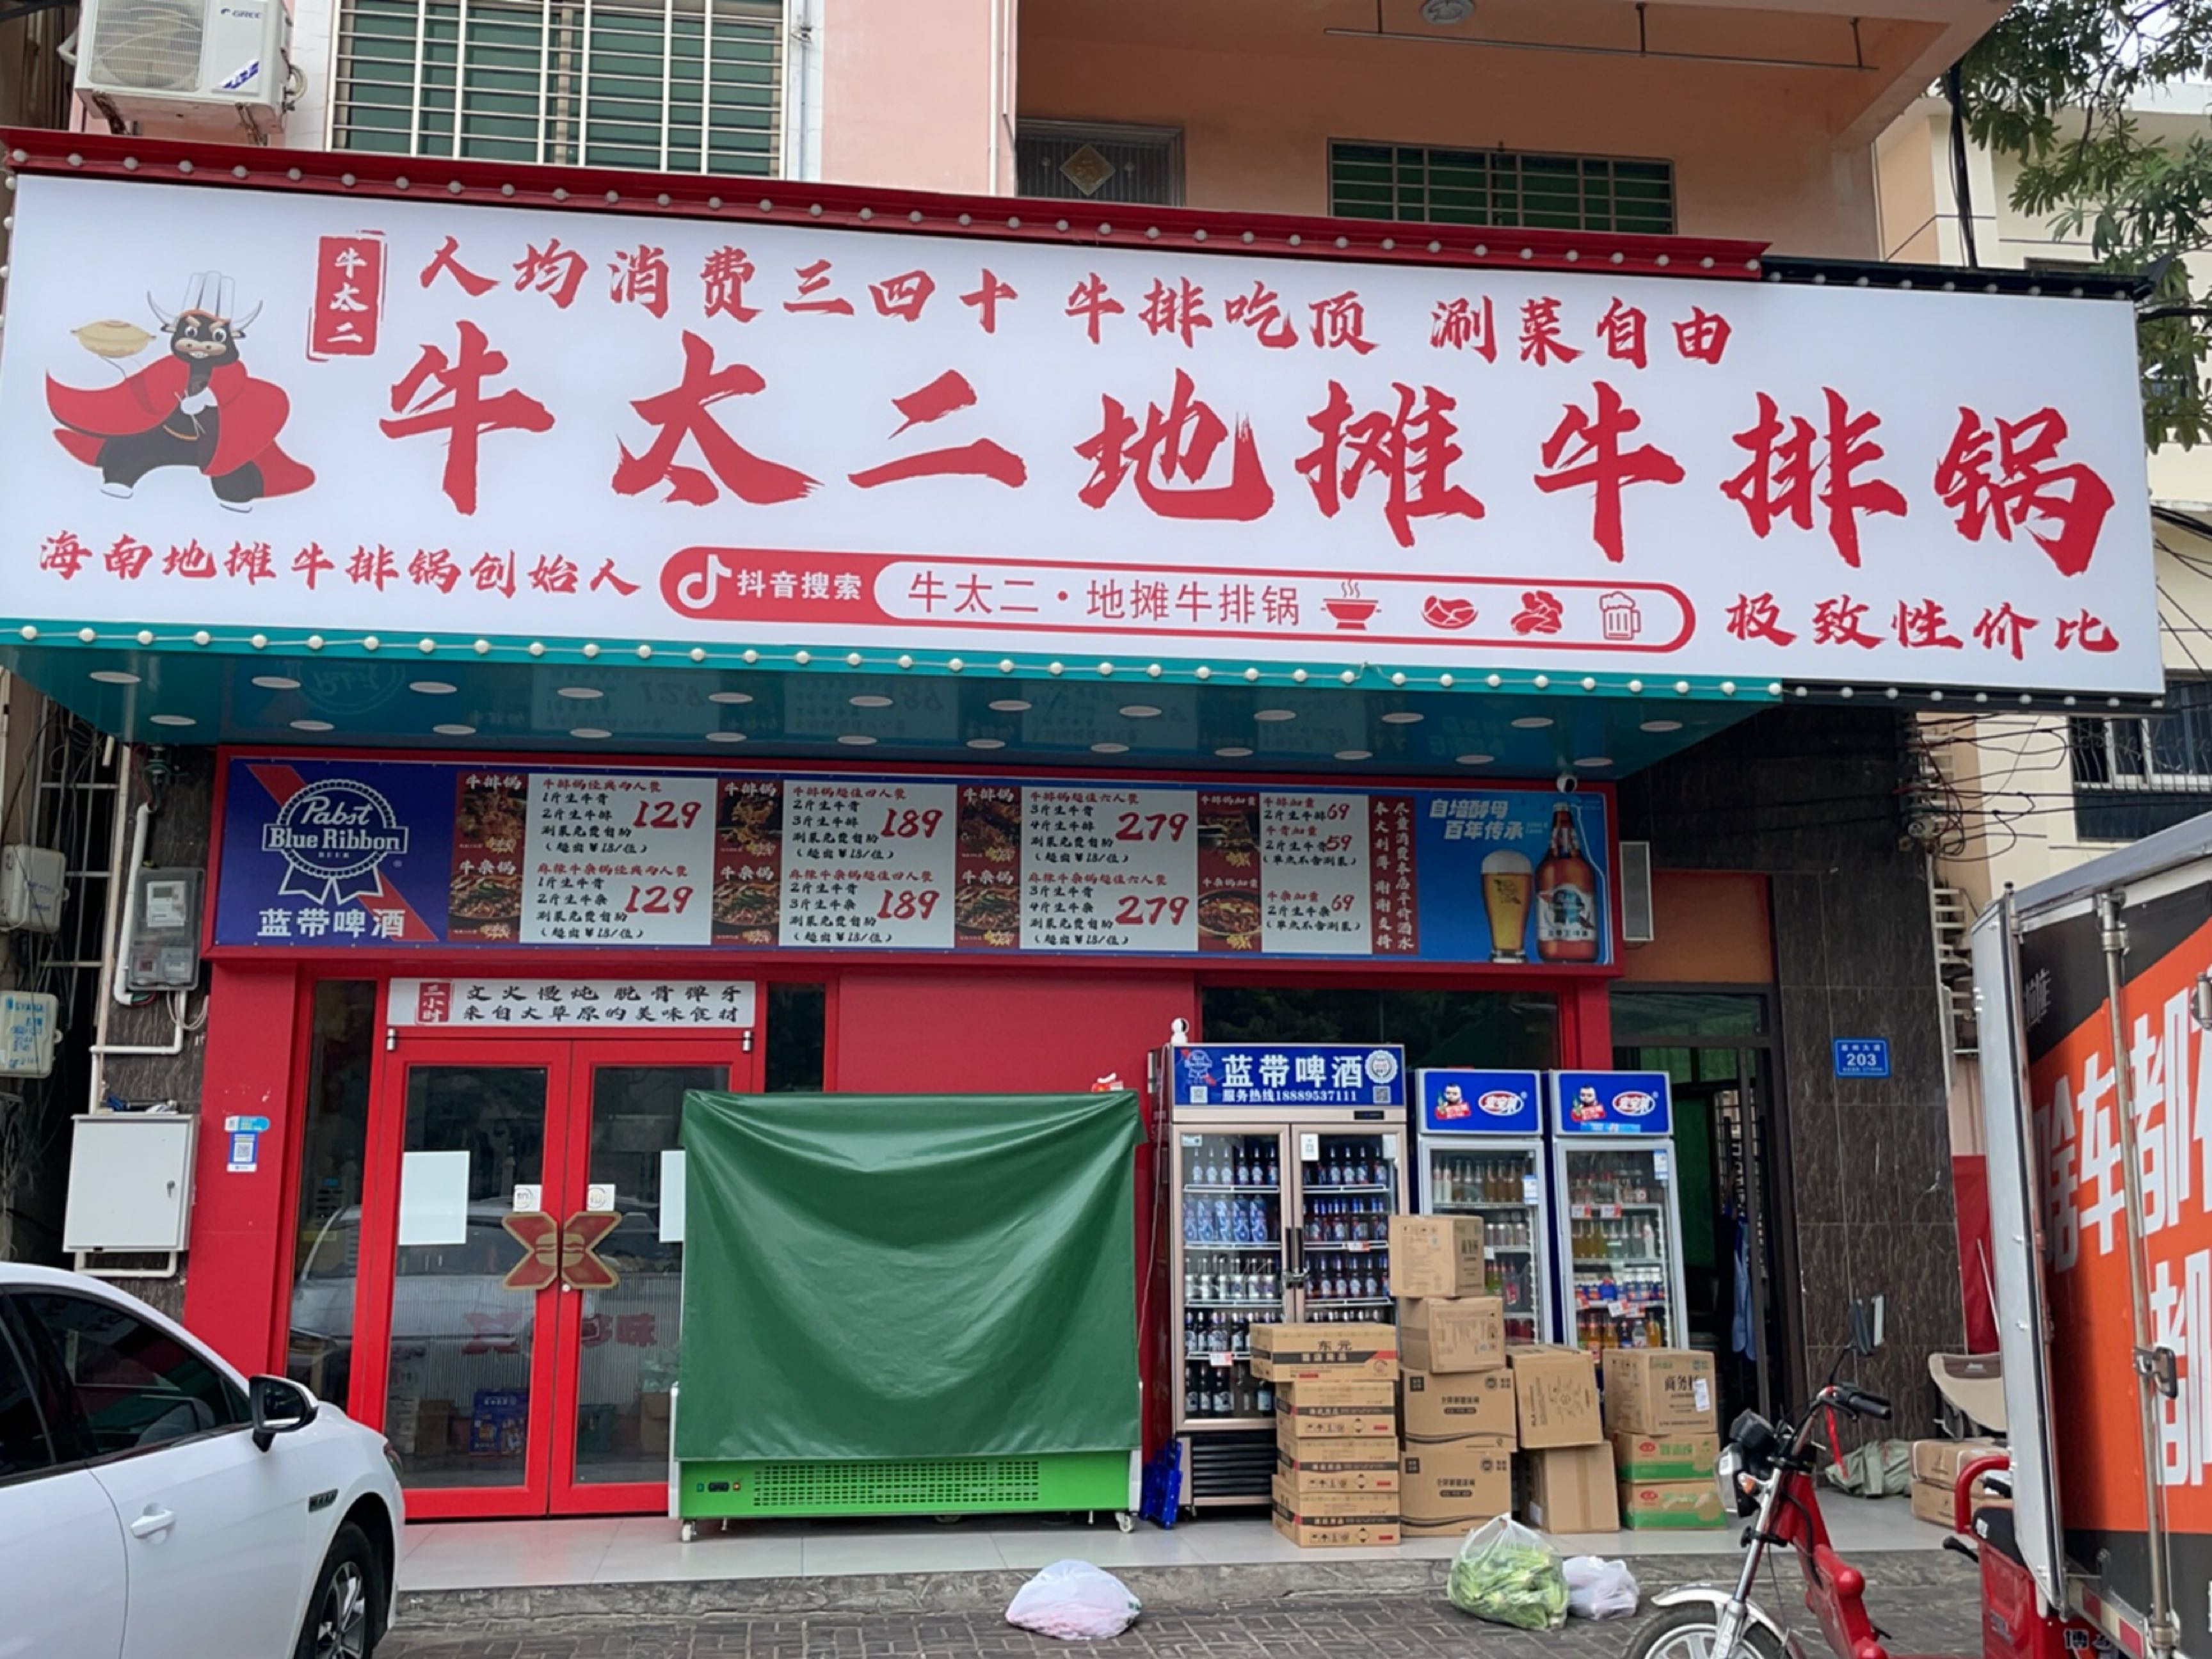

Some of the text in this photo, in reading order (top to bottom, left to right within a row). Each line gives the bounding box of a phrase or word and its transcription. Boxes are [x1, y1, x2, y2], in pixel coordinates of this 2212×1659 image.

[327, 247, 368, 344] 牛太二
[420, 236, 1733, 370] 人均消费三四十 牛排吃顶 涮菜自由
[379, 320, 2115, 576] 牛太二地摊牛排锅
[40, 529, 641, 598] 海南地摊牛排锅创始人
[737, 569, 862, 602] 抖音搜索
[1725, 592, 2120, 659] 极致性价比
[300, 796, 373, 826] Pabst
[632, 801, 701, 828] 129
[881, 808, 943, 838] 189
[1326, 803, 1350, 821] 69
[269, 828, 400, 851] Blue Ribbon
[1115, 812, 1189, 842] 279
[1444, 820, 1523, 840] 百年传承
[1325, 835, 1352, 852] 59
[625, 885, 693, 914] 129
[877, 889, 939, 920] 189
[1115, 895, 1189, 926] 279
[1331, 895, 1355, 911] 69
[257, 908, 405, 938] 蓝带啤酒
[463, 1007, 740, 1023] 来自大草原的美味食材
[1221, 1054, 1363, 1088] 蓝带啤酒
[1847, 1053, 1877, 1066] 203
[2033, 986, 2212, 1273] 啥车都
